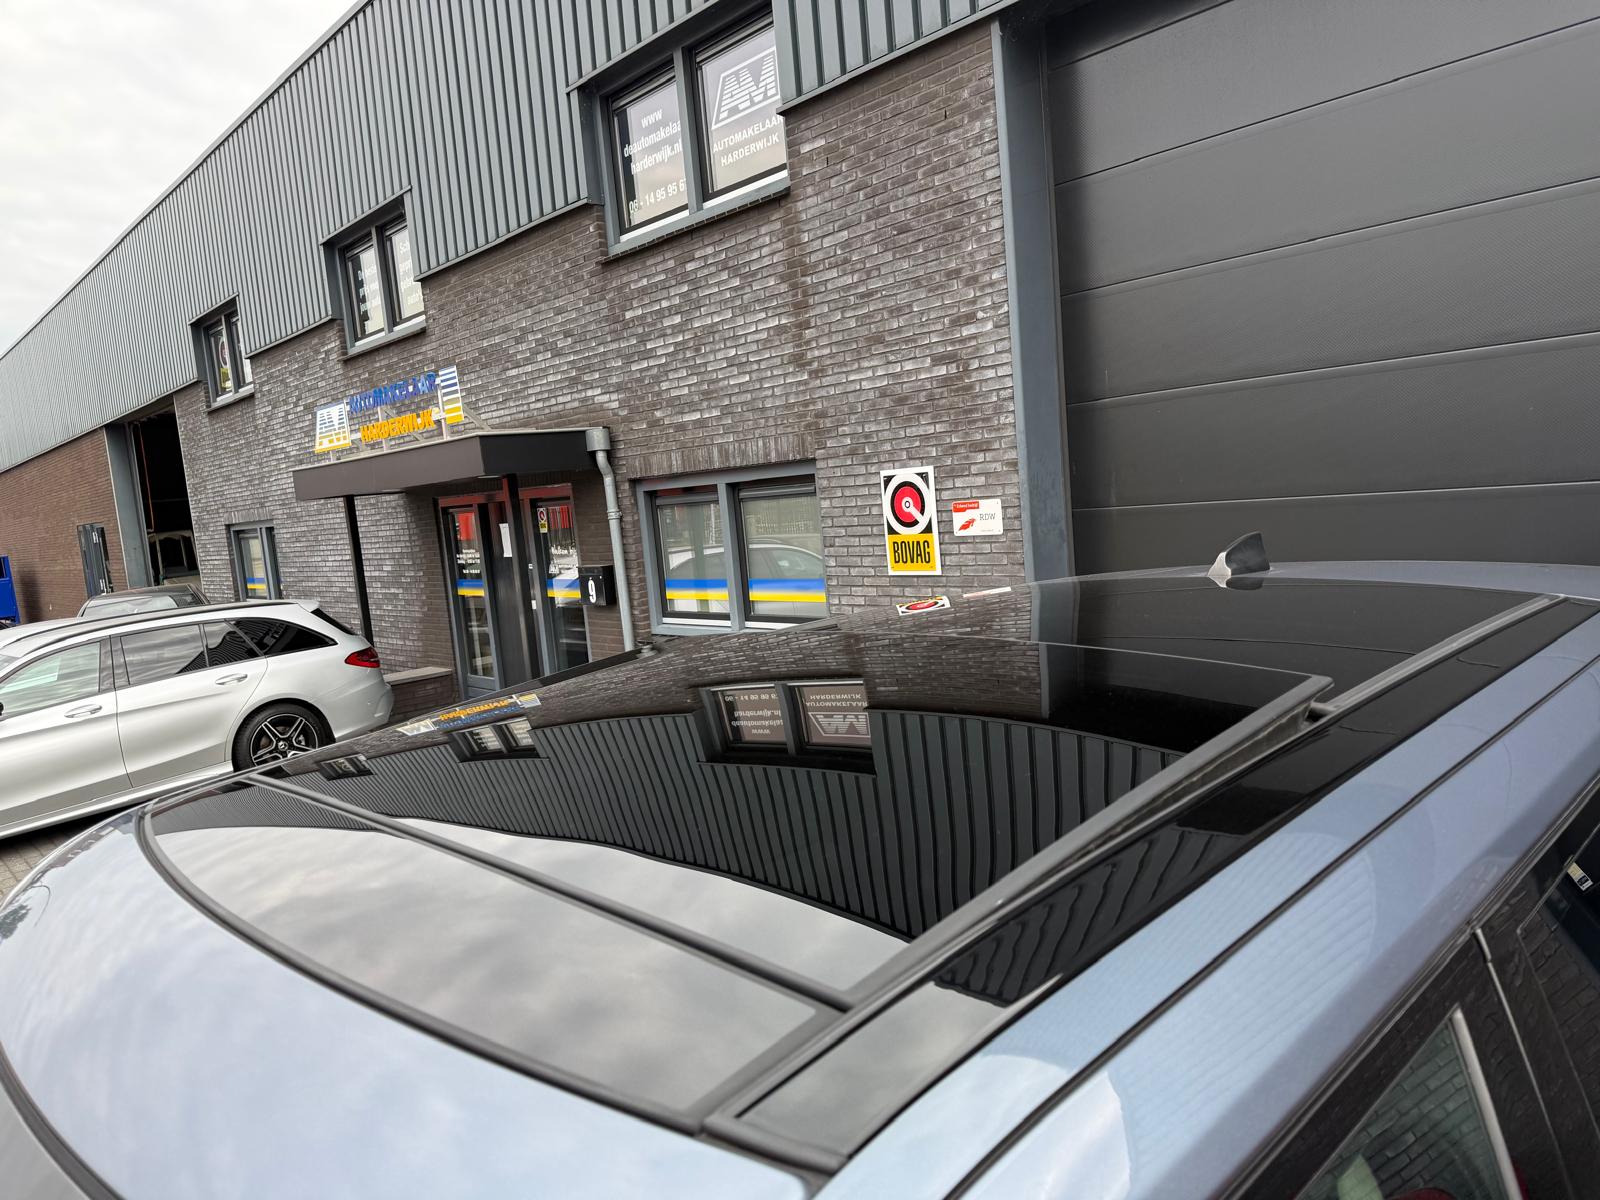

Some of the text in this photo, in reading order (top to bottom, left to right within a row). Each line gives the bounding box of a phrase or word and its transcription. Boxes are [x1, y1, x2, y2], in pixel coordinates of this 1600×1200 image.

[641, 109, 662, 128] www
[713, 115, 785, 153] AUTOMAKELAAR
[631, 139, 682, 175] harderwijk.nl
[720, 133, 780, 167] HARDERWIJK
[645, 191, 655, 206] 14
[656, 187, 666, 202] 95
[667, 182, 678, 198] 95
[679, 178, 687, 192] 6
[360, 408, 435, 442] HARDERWIJK
[979, 513, 996, 521] RDW
[892, 540, 931, 564] BOVAG
[588, 579, 597, 603] 9
